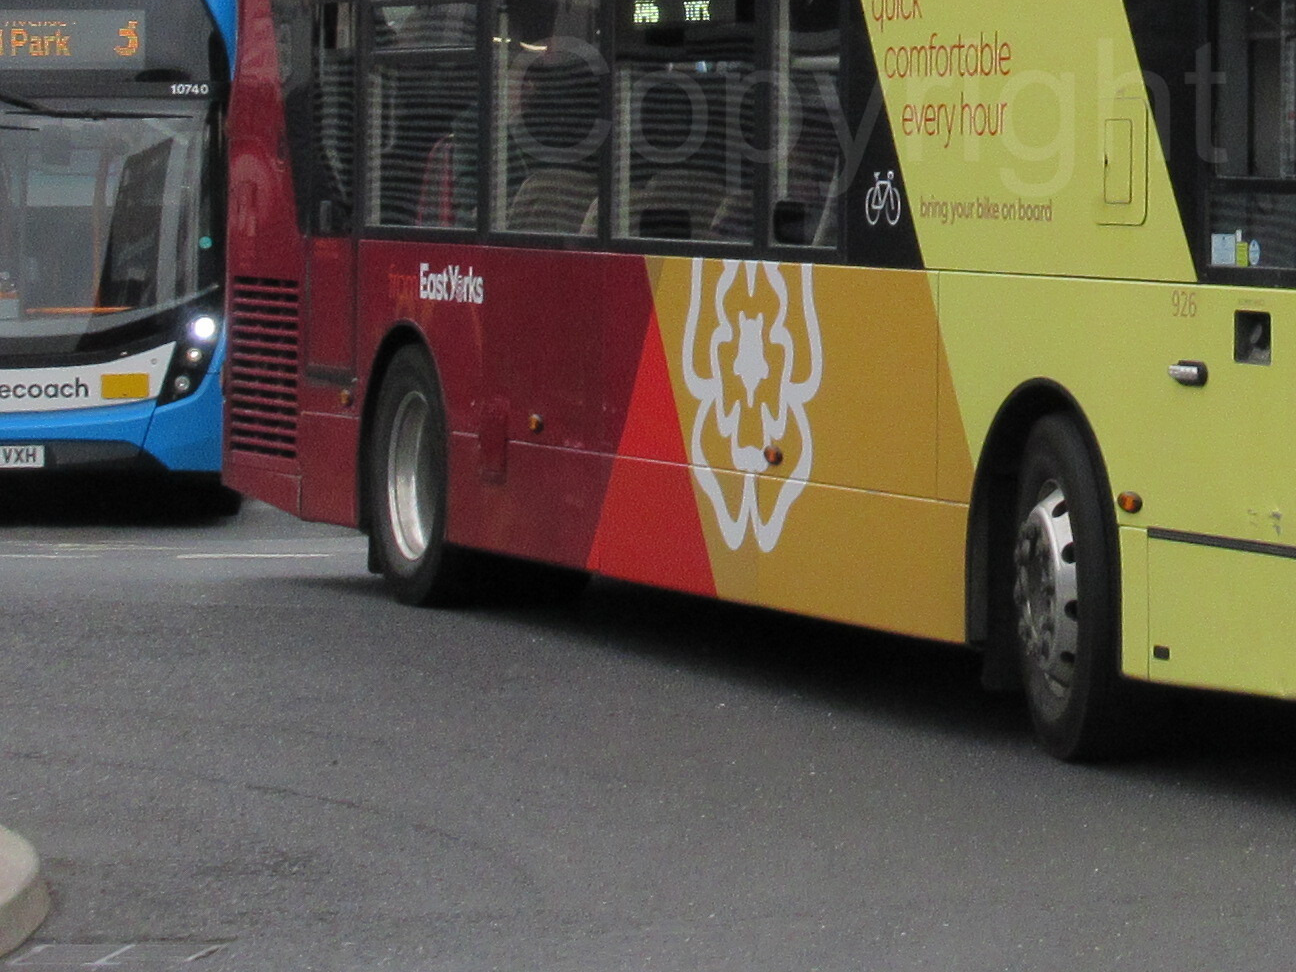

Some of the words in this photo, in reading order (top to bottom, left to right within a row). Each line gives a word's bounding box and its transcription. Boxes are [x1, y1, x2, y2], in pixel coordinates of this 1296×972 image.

[10, 28, 72, 57] Park
[883, 30, 1012, 79] comfortable
[170, 84, 210, 96] 10740
[901, 101, 957, 148] every
[960, 91, 1009, 136] hour
[920, 195, 949, 224] bring
[950, 201, 975, 225] your
[976, 196, 1000, 219] bike
[1001, 202, 1016, 220] on
[1017, 197, 1053, 222] board
[1171, 289, 1198, 317] 926
[0, 377, 90, 399] ecoach
[3, 448, 37, 464] VXH
